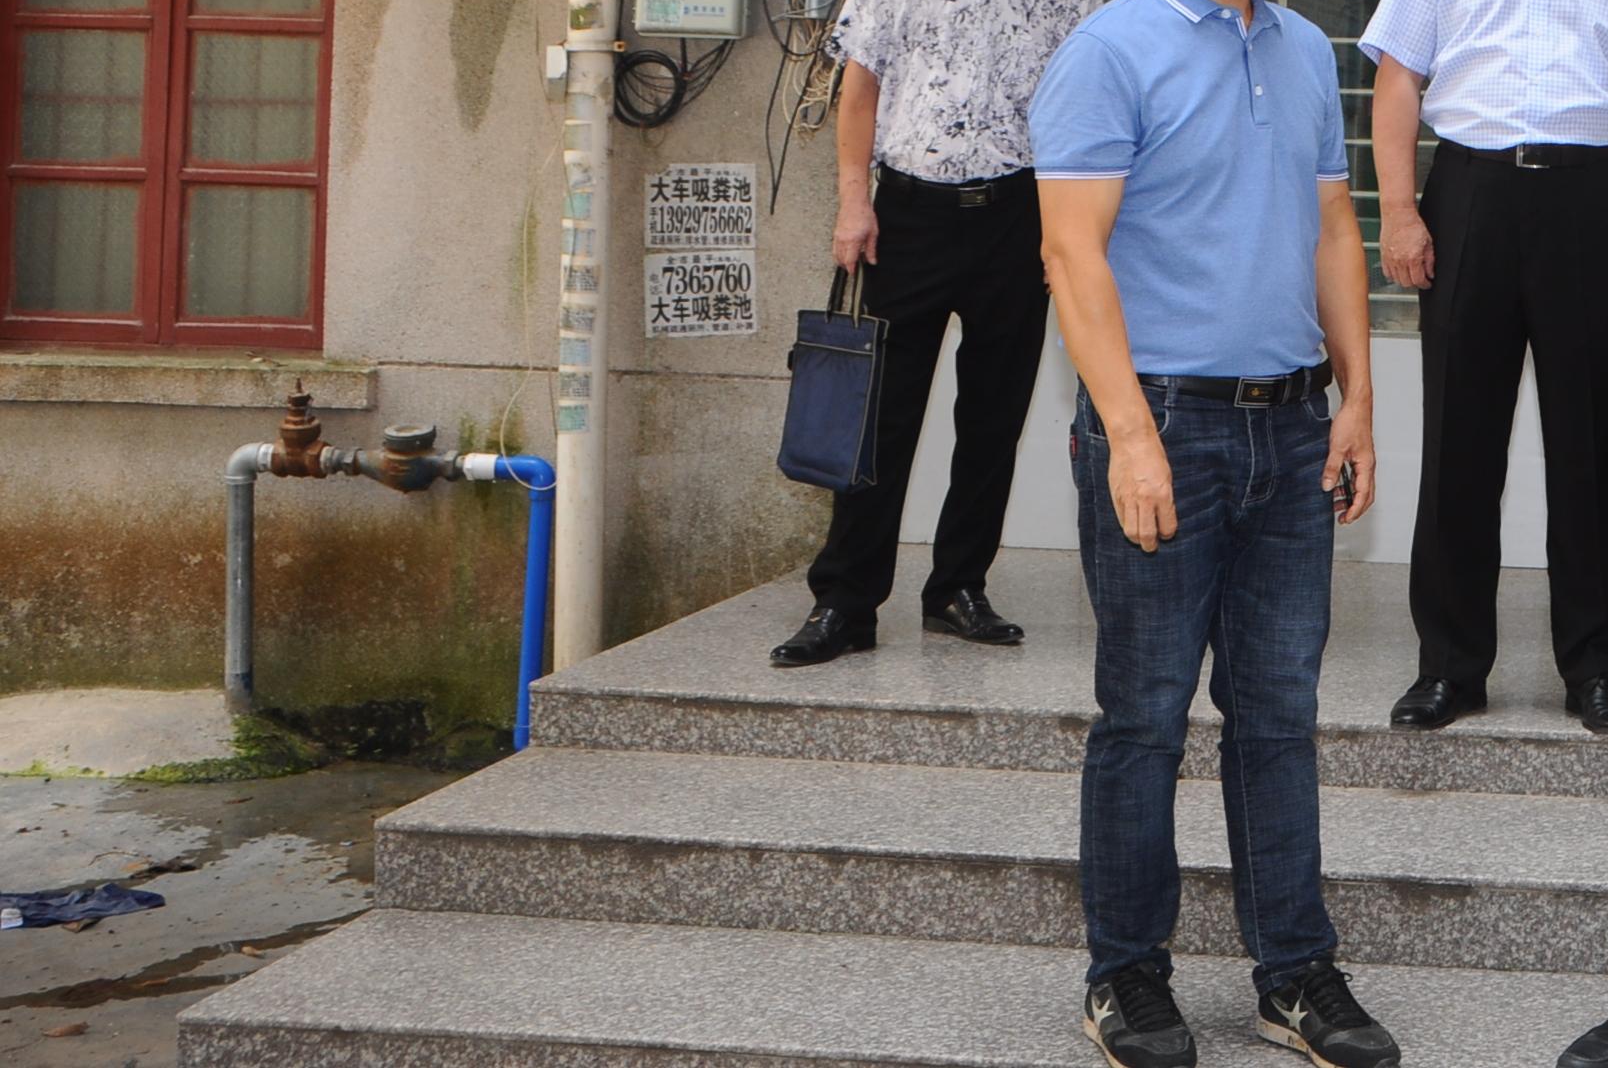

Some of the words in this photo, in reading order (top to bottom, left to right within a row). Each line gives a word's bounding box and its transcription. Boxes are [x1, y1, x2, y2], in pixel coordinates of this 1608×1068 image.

[650, 176, 752, 203] 大车吸粪池
[658, 205, 753, 233] 13929756662
[662, 262, 751, 295] 7365760
[651, 293, 753, 323] 大车吸粪池
